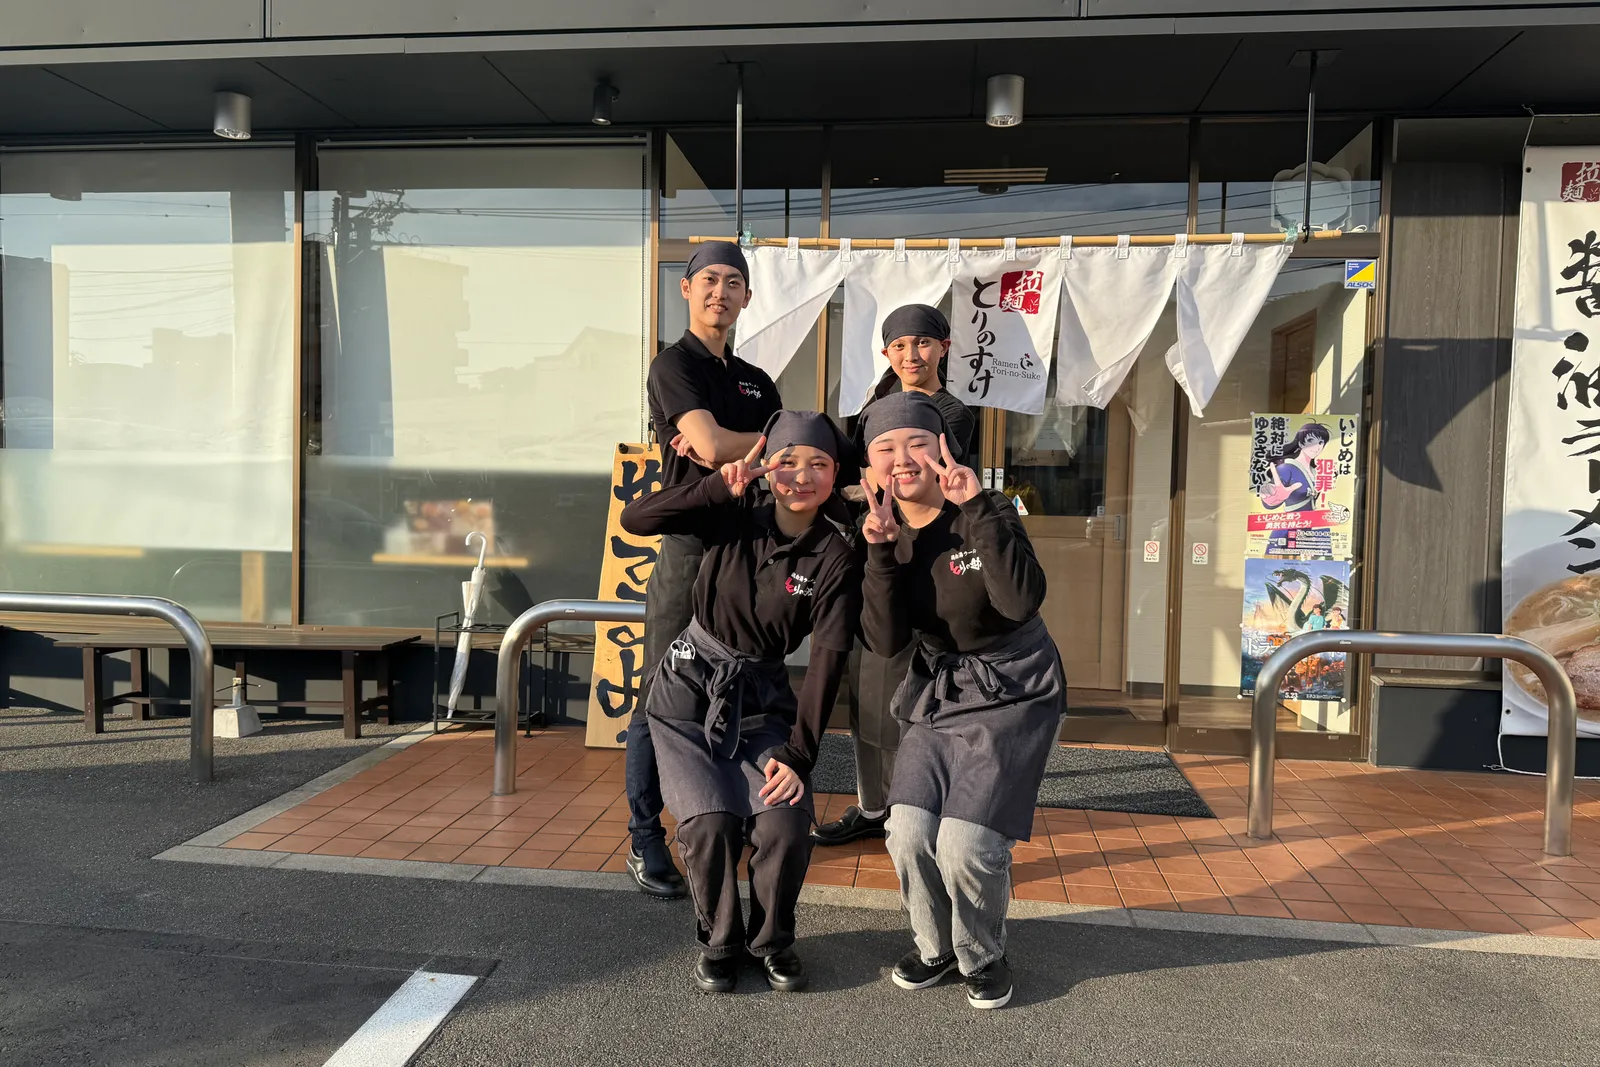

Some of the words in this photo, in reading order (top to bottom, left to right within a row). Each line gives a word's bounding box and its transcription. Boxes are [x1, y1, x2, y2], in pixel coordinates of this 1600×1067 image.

[961, 276, 998, 400] とりのすけ
[991, 366, 1041, 381] Tori-no-Suke
[992, 358, 1019, 369] Ramen
[1270, 416, 1286, 455] 絶対に
[1338, 418, 1356, 475] いじめは
[1252, 416, 1269, 498] ゆるさない！
[1257, 512, 1302, 522] いじめと戦う
